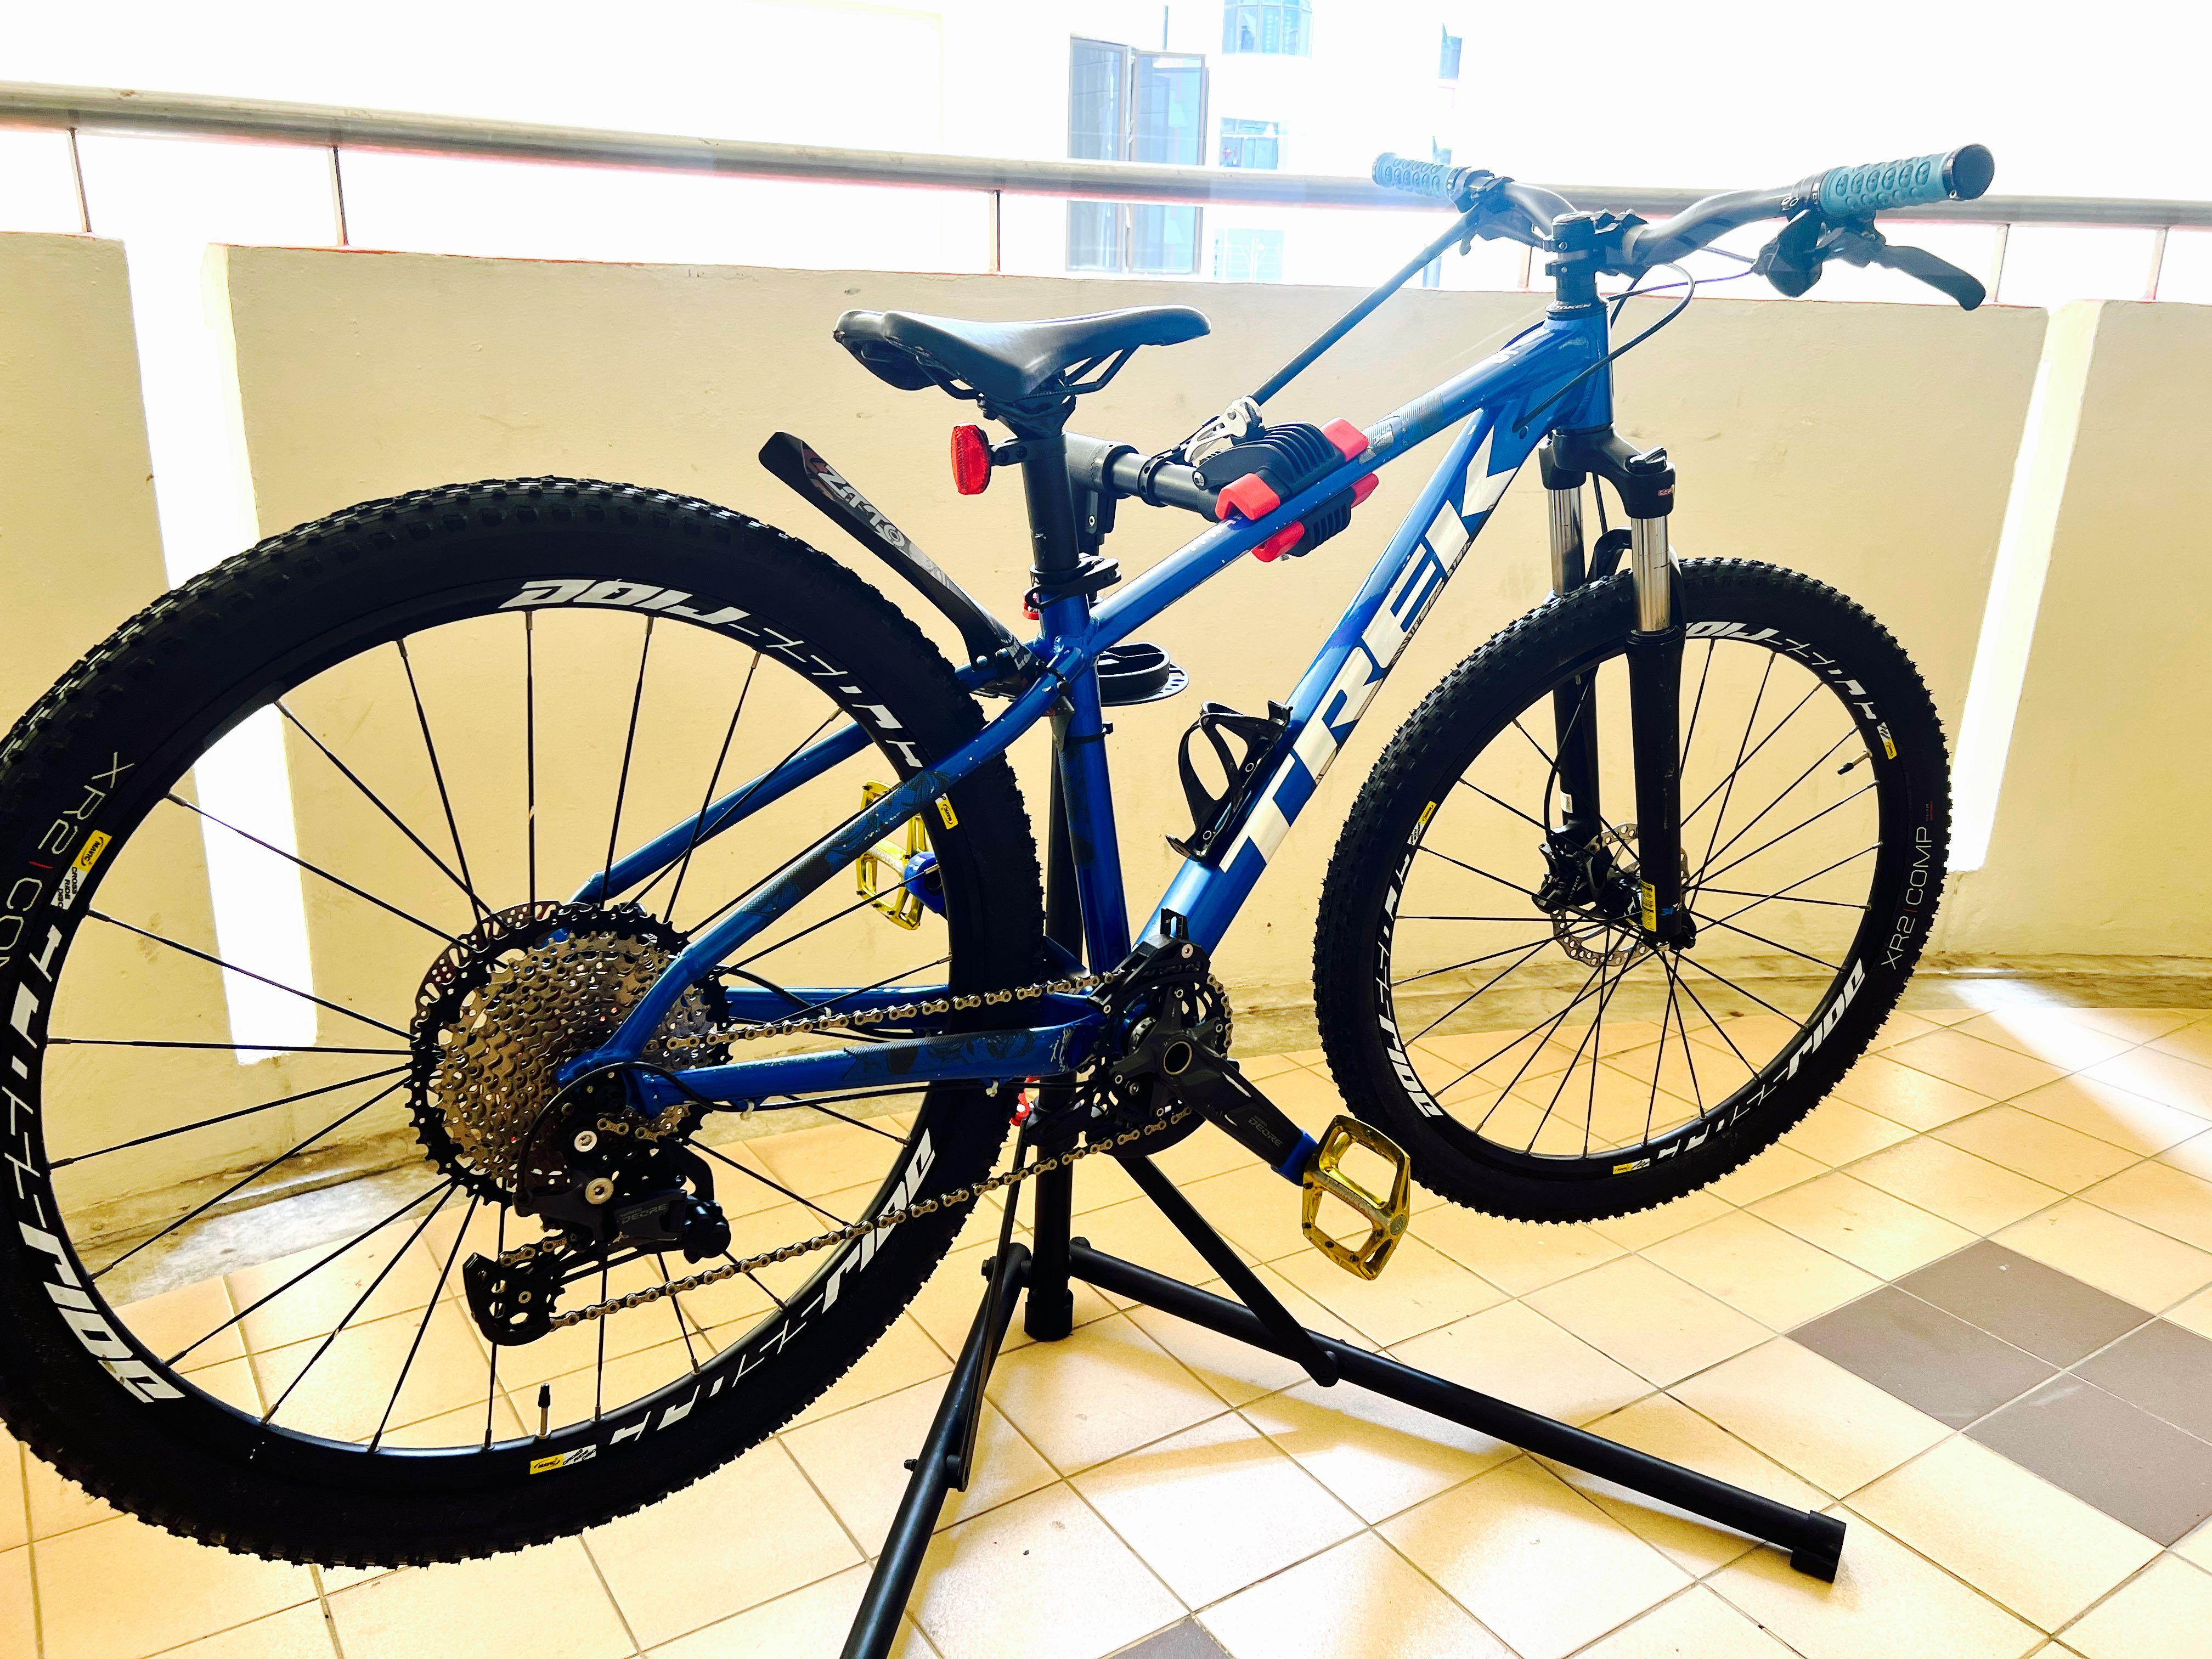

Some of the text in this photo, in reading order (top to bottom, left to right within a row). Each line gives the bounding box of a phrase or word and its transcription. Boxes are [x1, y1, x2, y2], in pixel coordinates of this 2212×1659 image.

[817, 465, 906, 547] ZTTO
[1220, 425, 1519, 873] TREK
[38, 752, 134, 854] XR2
[84, 840, 100, 862] MAVIC
[0, 878, 42, 967] CO
[1881, 827, 1932, 970] XR2 COMP
[1248, 1116, 1283, 1148] DEORE
[621, 1203, 667, 1224] DEORE
